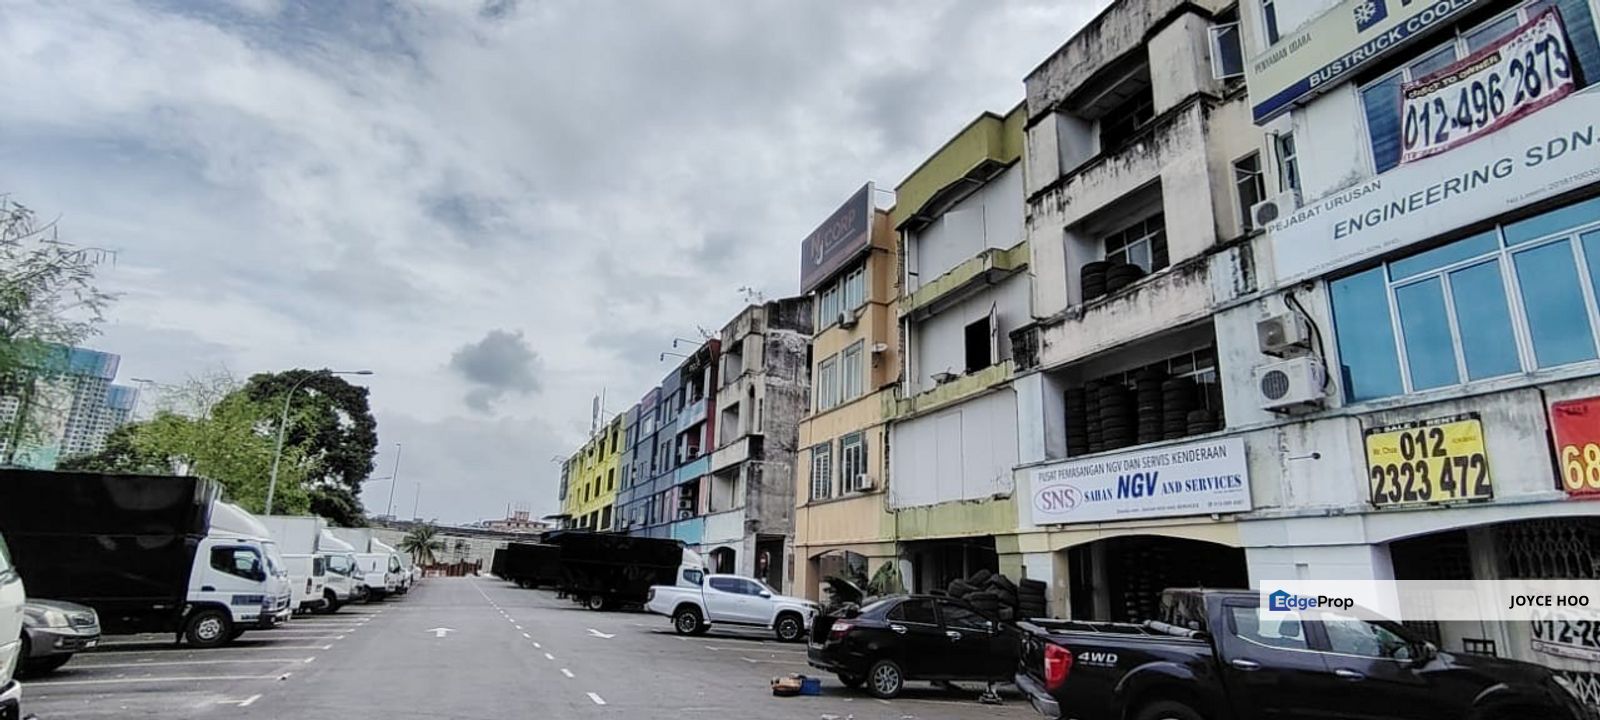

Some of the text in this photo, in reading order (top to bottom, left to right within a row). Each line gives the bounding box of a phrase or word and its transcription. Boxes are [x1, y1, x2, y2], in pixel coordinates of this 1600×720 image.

[1309, 26, 1404, 88] BUSTRUCK
[1509, 33, 1571, 106] 2873
[1442, 75, 1457, 85] TO
[1268, 180, 1382, 234] PEJABAT URUSAN
[1334, 158, 1513, 240] ENGINEERING
[824, 208, 856, 248] CORP
[1106, 461, 1122, 473] NGV
[1123, 458, 1141, 471] DAN
[1142, 454, 1170, 469] SERVIS
[1171, 445, 1227, 464] KENDERAAN
[1400, 427, 1448, 460] 012
[1117, 471, 1159, 499] NGV
[1162, 480, 1183, 495] AND
[1185, 474, 1243, 492] SERVICES
[1371, 453, 1492, 503] 2323 472
[1042, 489, 1075, 510] SNS
[1078, 652, 1118, 663] 4WD
